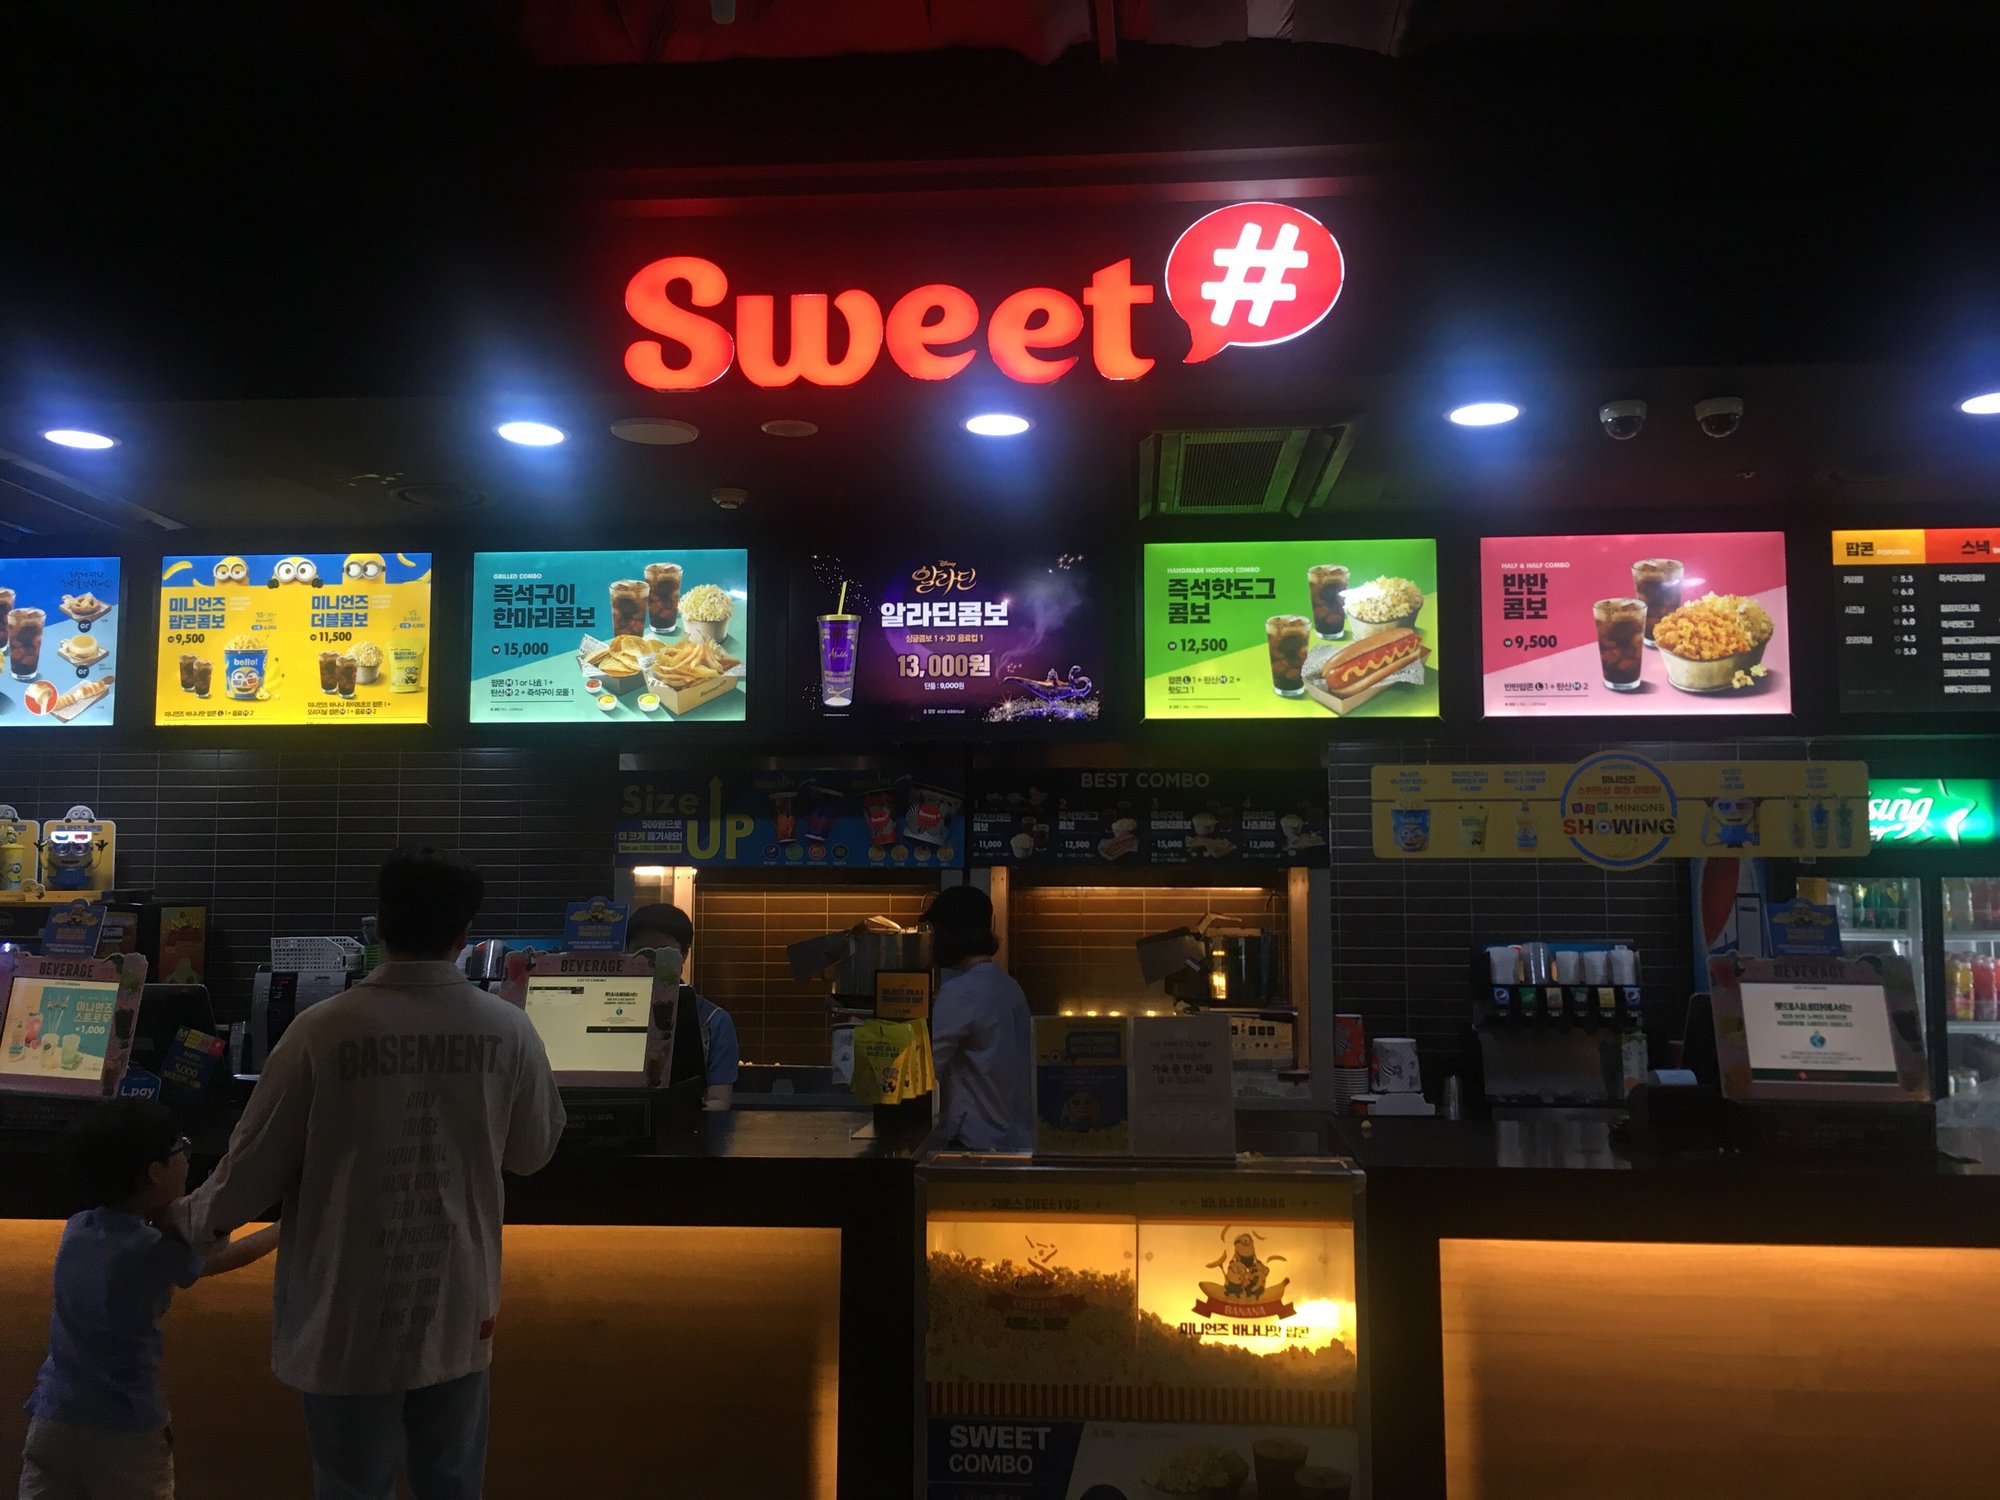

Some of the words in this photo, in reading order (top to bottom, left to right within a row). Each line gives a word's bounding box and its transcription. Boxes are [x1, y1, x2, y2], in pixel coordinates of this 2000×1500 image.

[624, 255, 1154, 388] Sweet
[1845, 541, 1874, 557] 팝콘
[1961, 540, 1990, 555] 스낵
[911, 565, 977, 597] 알라딘
[1168, 577, 1276, 601] 즉석핫도그
[1503, 573, 1548, 595] 반반
[311, 594, 369, 610] 미니언즈
[493, 583, 576, 606] 즉석구이
[169, 597, 226, 612] 미니언즈
[1503, 597, 1548, 620] 콤보
[311, 612, 369, 628] 더블콤보
[493, 606, 596, 629] 한마리콤보
[880, 601, 1009, 627] 알라딘콤보
[1168, 602, 1211, 624] 콤보
[169, 615, 225, 630] 팝콘콤보
[175, 633, 205, 646] 9,500
[319, 631, 352, 643] 11,500
[946, 634, 956, 642] 3D
[1515, 635, 1558, 651] 9,500
[504, 642, 549, 658] 15,000
[1181, 638, 1228, 654] 12,500
[897, 653, 991, 678] 13,000원
[527, 688, 554, 697] 즉석구이
[940, 682, 965, 690] 9,000원
[1080, 772, 1130, 788] BEST
[1136, 772, 1210, 788] COMBO
[1614, 803, 1665, 812] MINIONS
[622, 784, 701, 815] Size
[686, 776, 755, 860] UP
[642, 819, 682, 829] 500원으로
[619, 831, 628, 841] 더
[628, 831, 646, 841] 크게
[39, 962, 94, 978] BEVERAGE
[560, 959, 624, 972] BEVERAGE
[1773, 964, 1847, 978] BEVERAGE
[76, 1000, 112, 1012] 미니언즈
[73, 1013, 112, 1024] 스트로우
[81, 1025, 105, 1035] 1,000
[338, 1034, 502, 1080] BASEMENT
[1024, 1199, 1081, 1211] CHEETOS
[1236, 1197, 1286, 1208] BANANA
[1012, 1298, 1060, 1310] CHEETOS
[1224, 1305, 1267, 1317] BANANA
[1180, 1322, 1229, 1336] 미니언즈
[1232, 1322, 1282, 1338] 바나나맛
[949, 1425, 1052, 1450] SWEET
[949, 1454, 1034, 1475] COMBO
